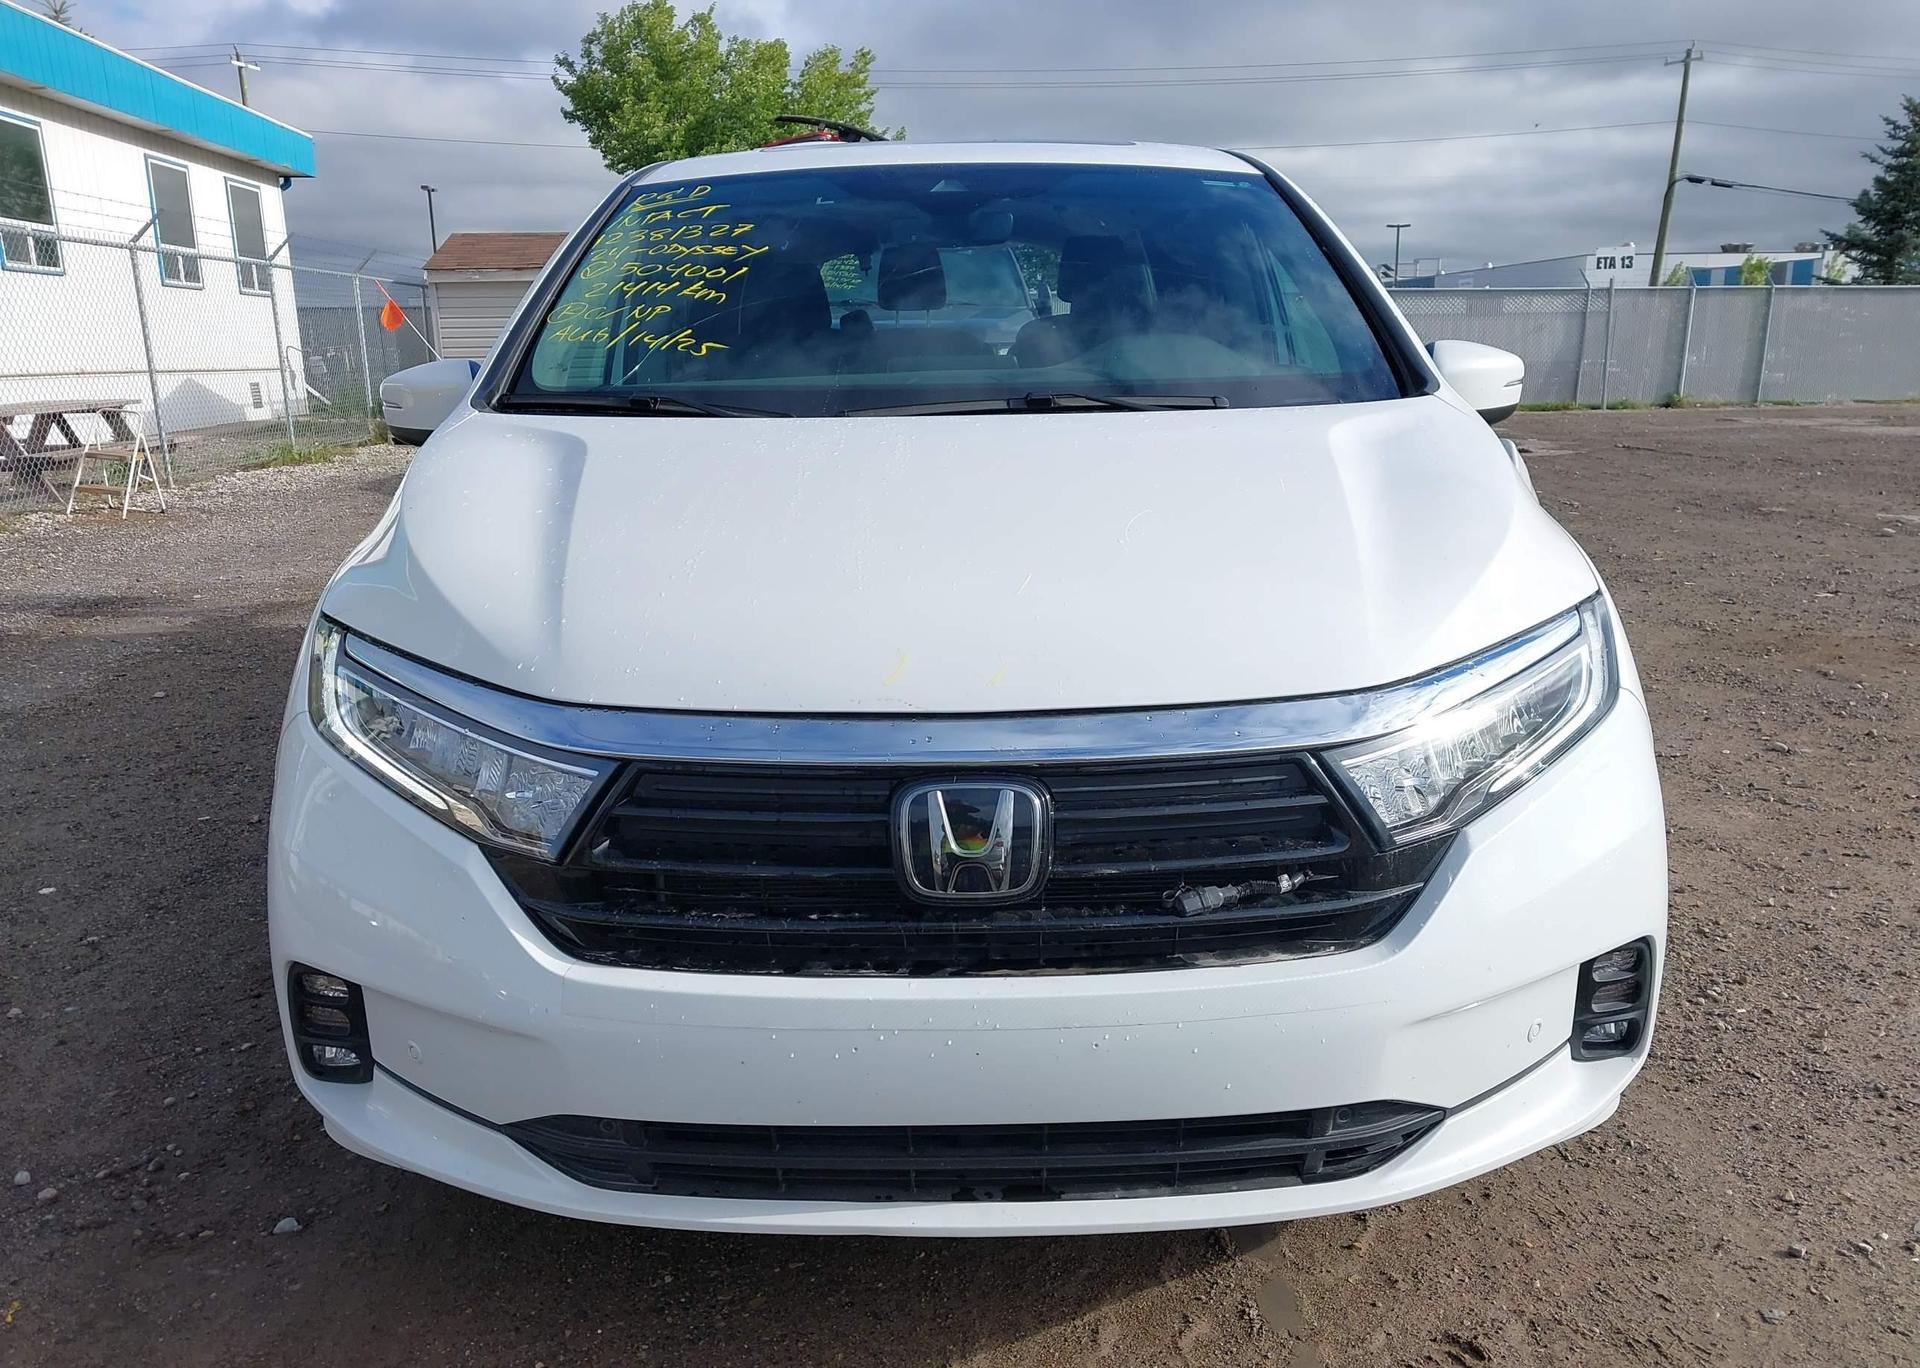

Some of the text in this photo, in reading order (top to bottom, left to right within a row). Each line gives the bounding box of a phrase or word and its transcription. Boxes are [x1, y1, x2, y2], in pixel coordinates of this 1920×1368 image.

[605, 204, 731, 232] INTACT
[592, 223, 755, 249] 12381327
[615, 262, 749, 284] 504001
[1596, 255, 1634, 269] ETA 13
[585, 281, 680, 300] 21414
